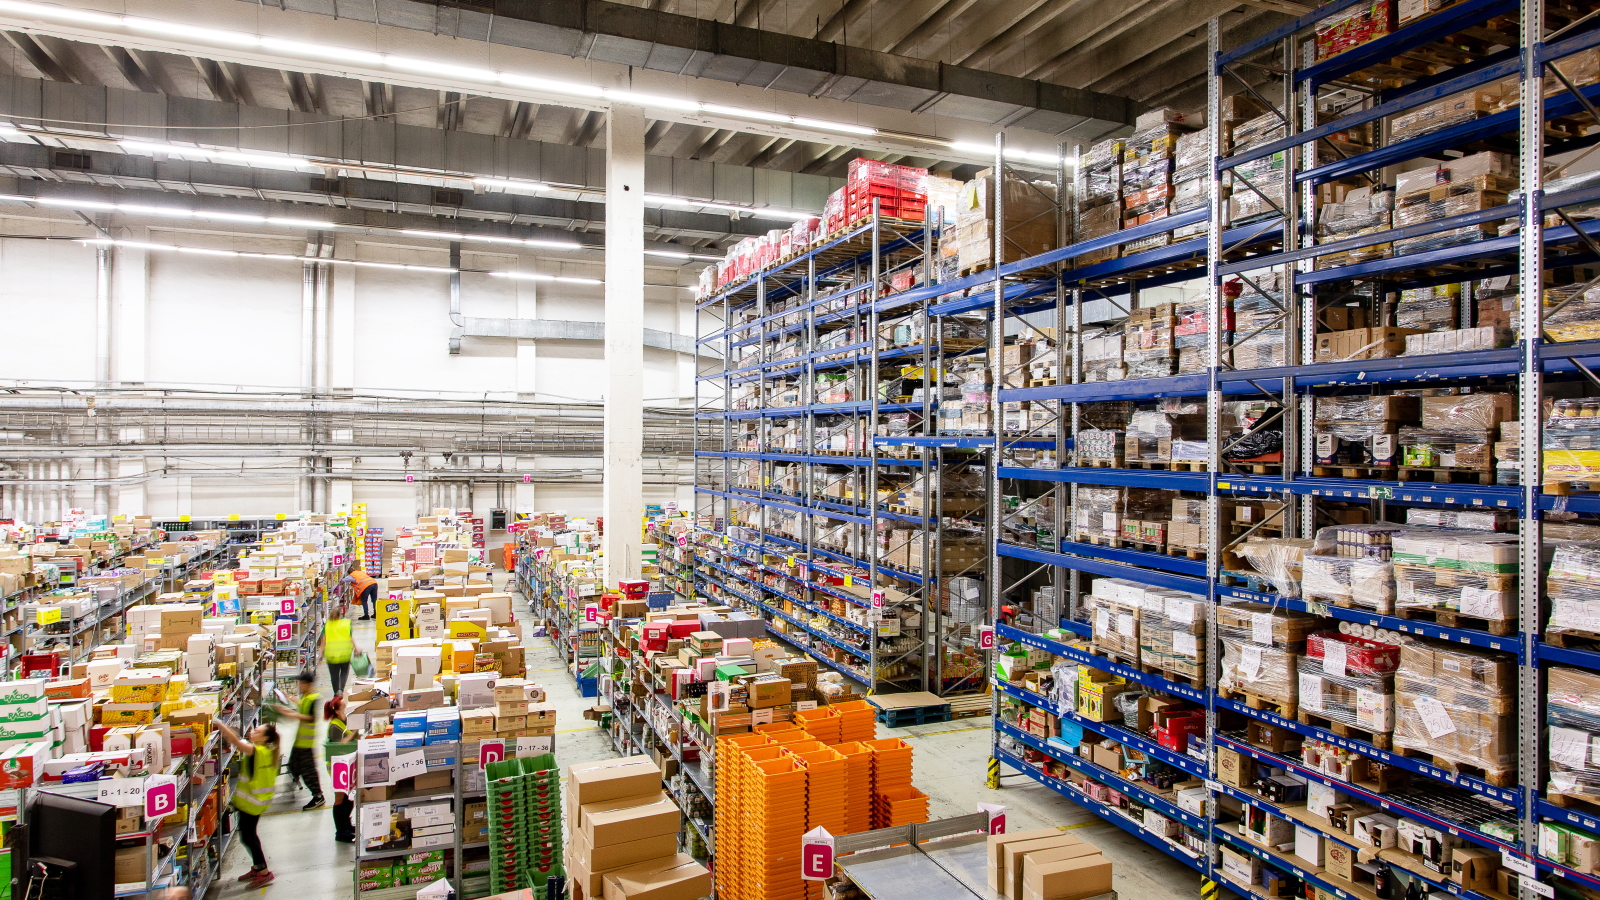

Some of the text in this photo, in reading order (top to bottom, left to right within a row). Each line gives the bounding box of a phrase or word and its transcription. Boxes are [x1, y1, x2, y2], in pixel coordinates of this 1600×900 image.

[386, 603, 398, 611] TUC
[386, 618, 398, 626] TUC
[281, 629, 288, 637] B
[387, 632, 399, 640] TUC
[984, 636, 991, 644] G
[4, 694, 29, 702] RACIO
[8, 711, 33, 720] RACIO
[486, 751, 498, 761] D
[340, 771, 347, 786] C
[155, 794, 168, 811] B
[813, 854, 823, 872] E
